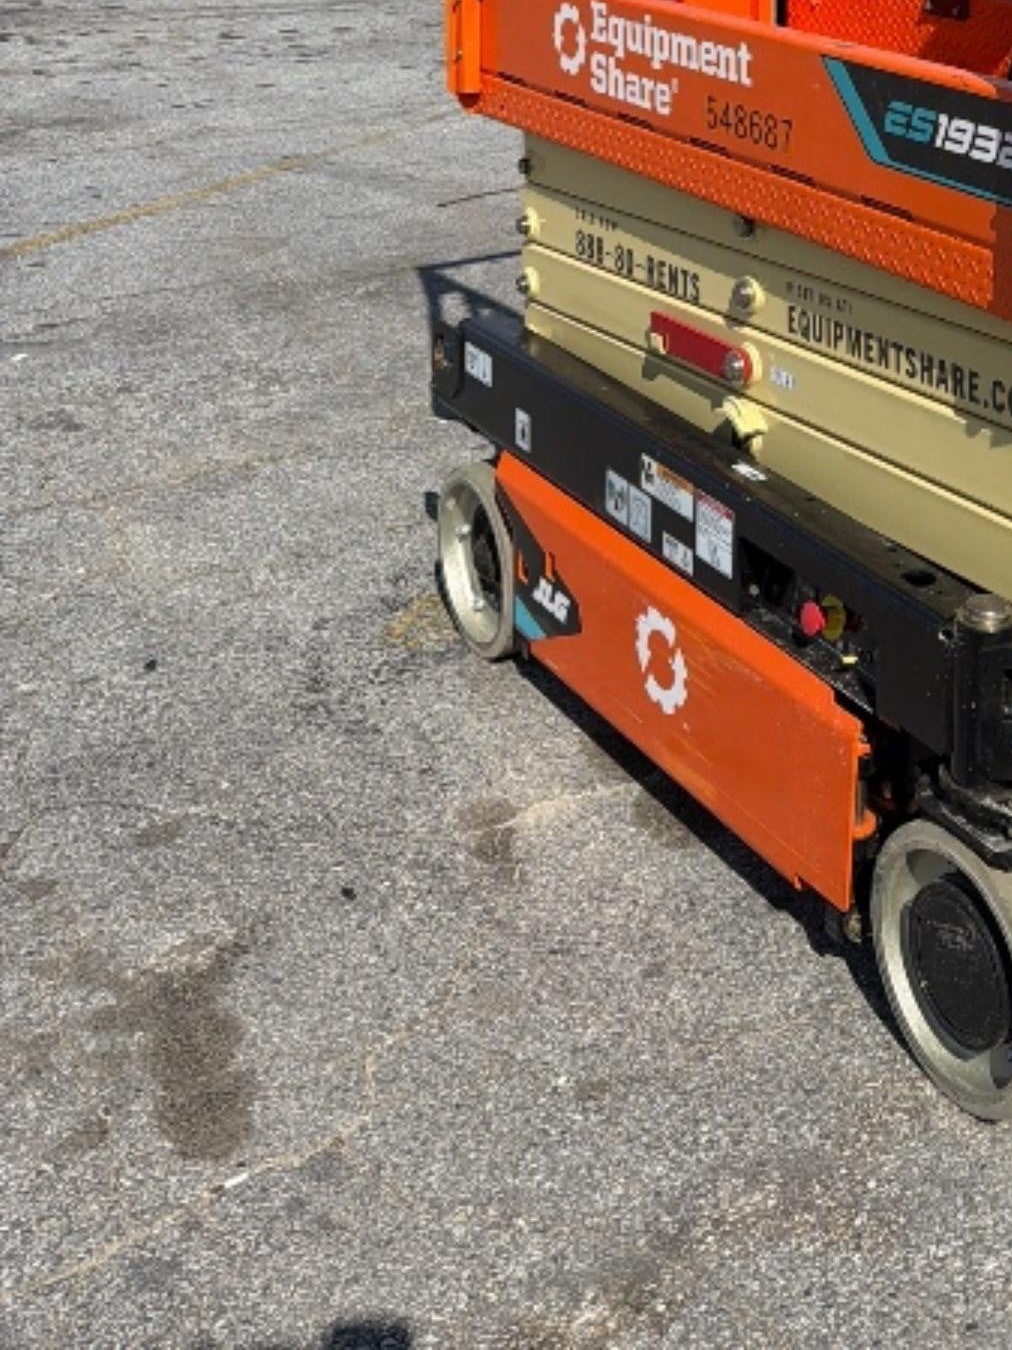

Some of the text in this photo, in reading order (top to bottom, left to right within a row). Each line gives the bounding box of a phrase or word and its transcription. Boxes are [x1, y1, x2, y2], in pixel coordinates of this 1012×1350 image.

[590, 0, 753, 88] Equipment
[590, 52, 674, 116] Share
[704, 95, 794, 153] 548687
[532, 576, 571, 625] JLG
